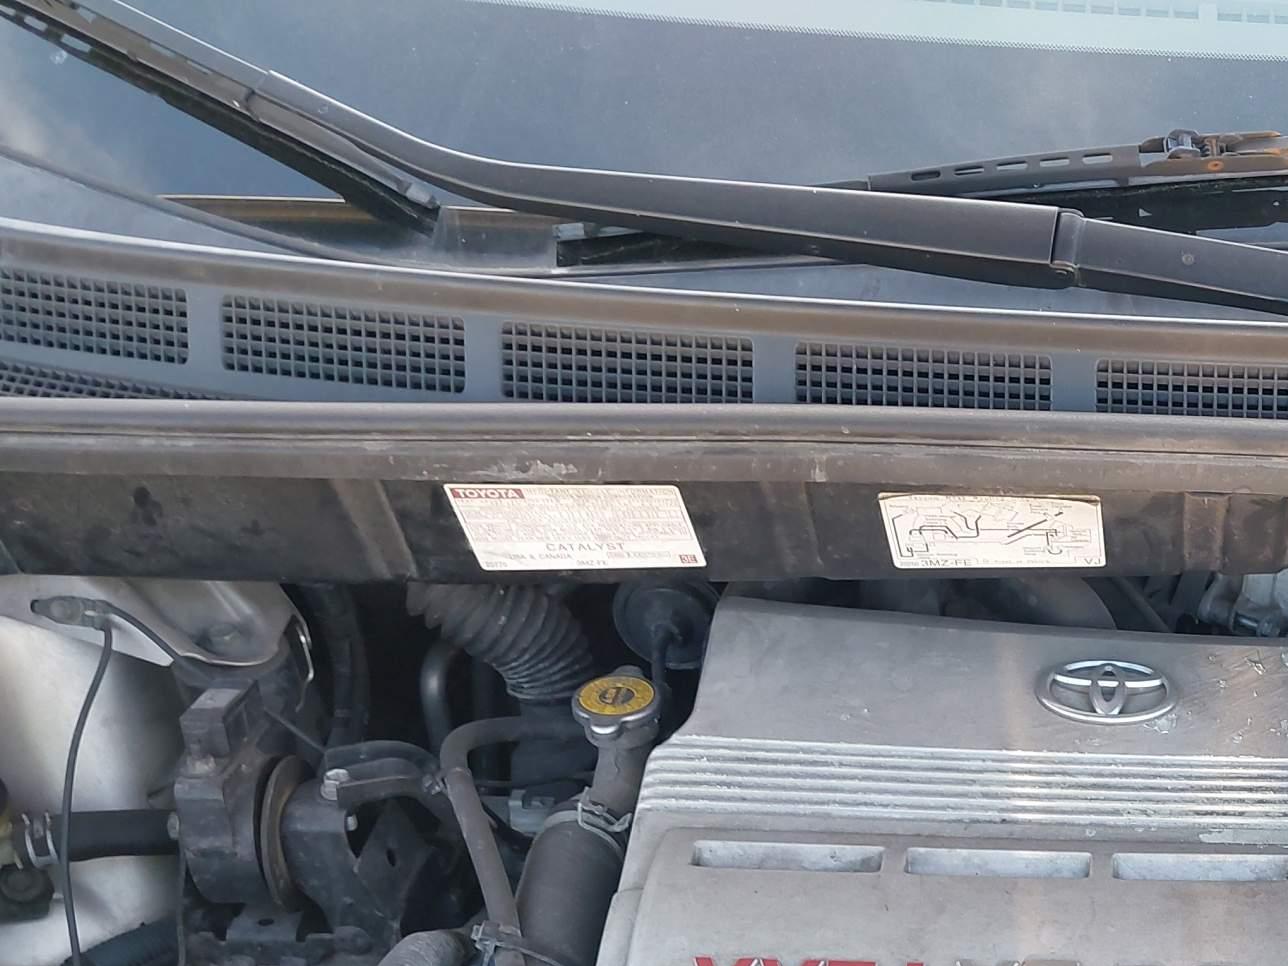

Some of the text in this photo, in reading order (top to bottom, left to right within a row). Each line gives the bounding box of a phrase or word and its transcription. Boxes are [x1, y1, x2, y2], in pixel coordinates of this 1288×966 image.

[454, 488, 522, 499] TOYOTA
[546, 543, 626, 552] CATALYST
[921, 559, 973, 567] 3MZ-FE
